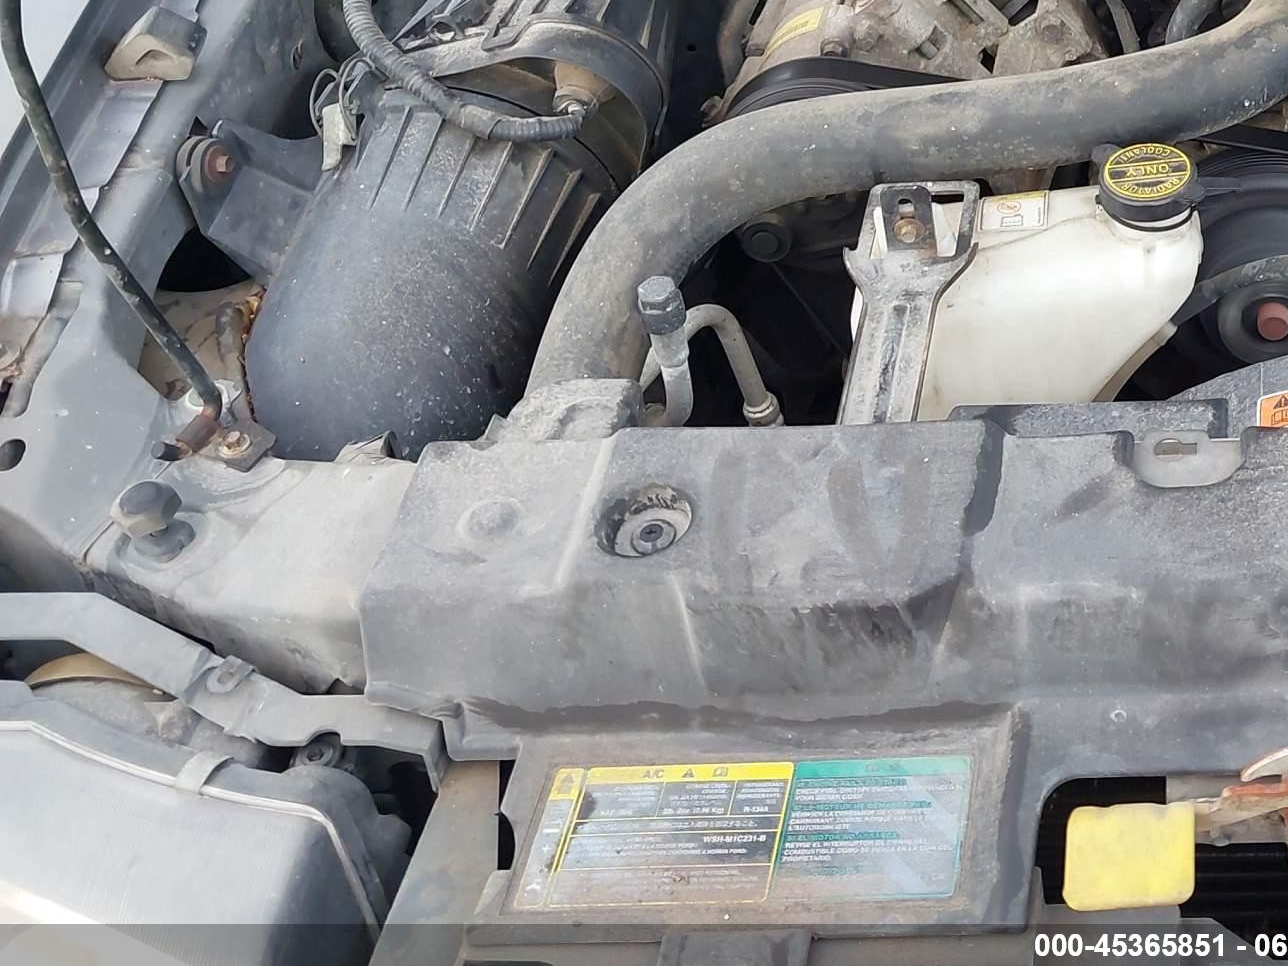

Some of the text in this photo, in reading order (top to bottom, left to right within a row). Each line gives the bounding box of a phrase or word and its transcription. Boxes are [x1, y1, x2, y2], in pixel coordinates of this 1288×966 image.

[1120, 146, 1171, 163] COOLANT
[1126, 164, 1170, 178] ONLY
[1121, 177, 1181, 195] RADIATOR
[643, 770, 665, 779] A/C
[703, 835, 767, 843] WSH-M1C231-B
